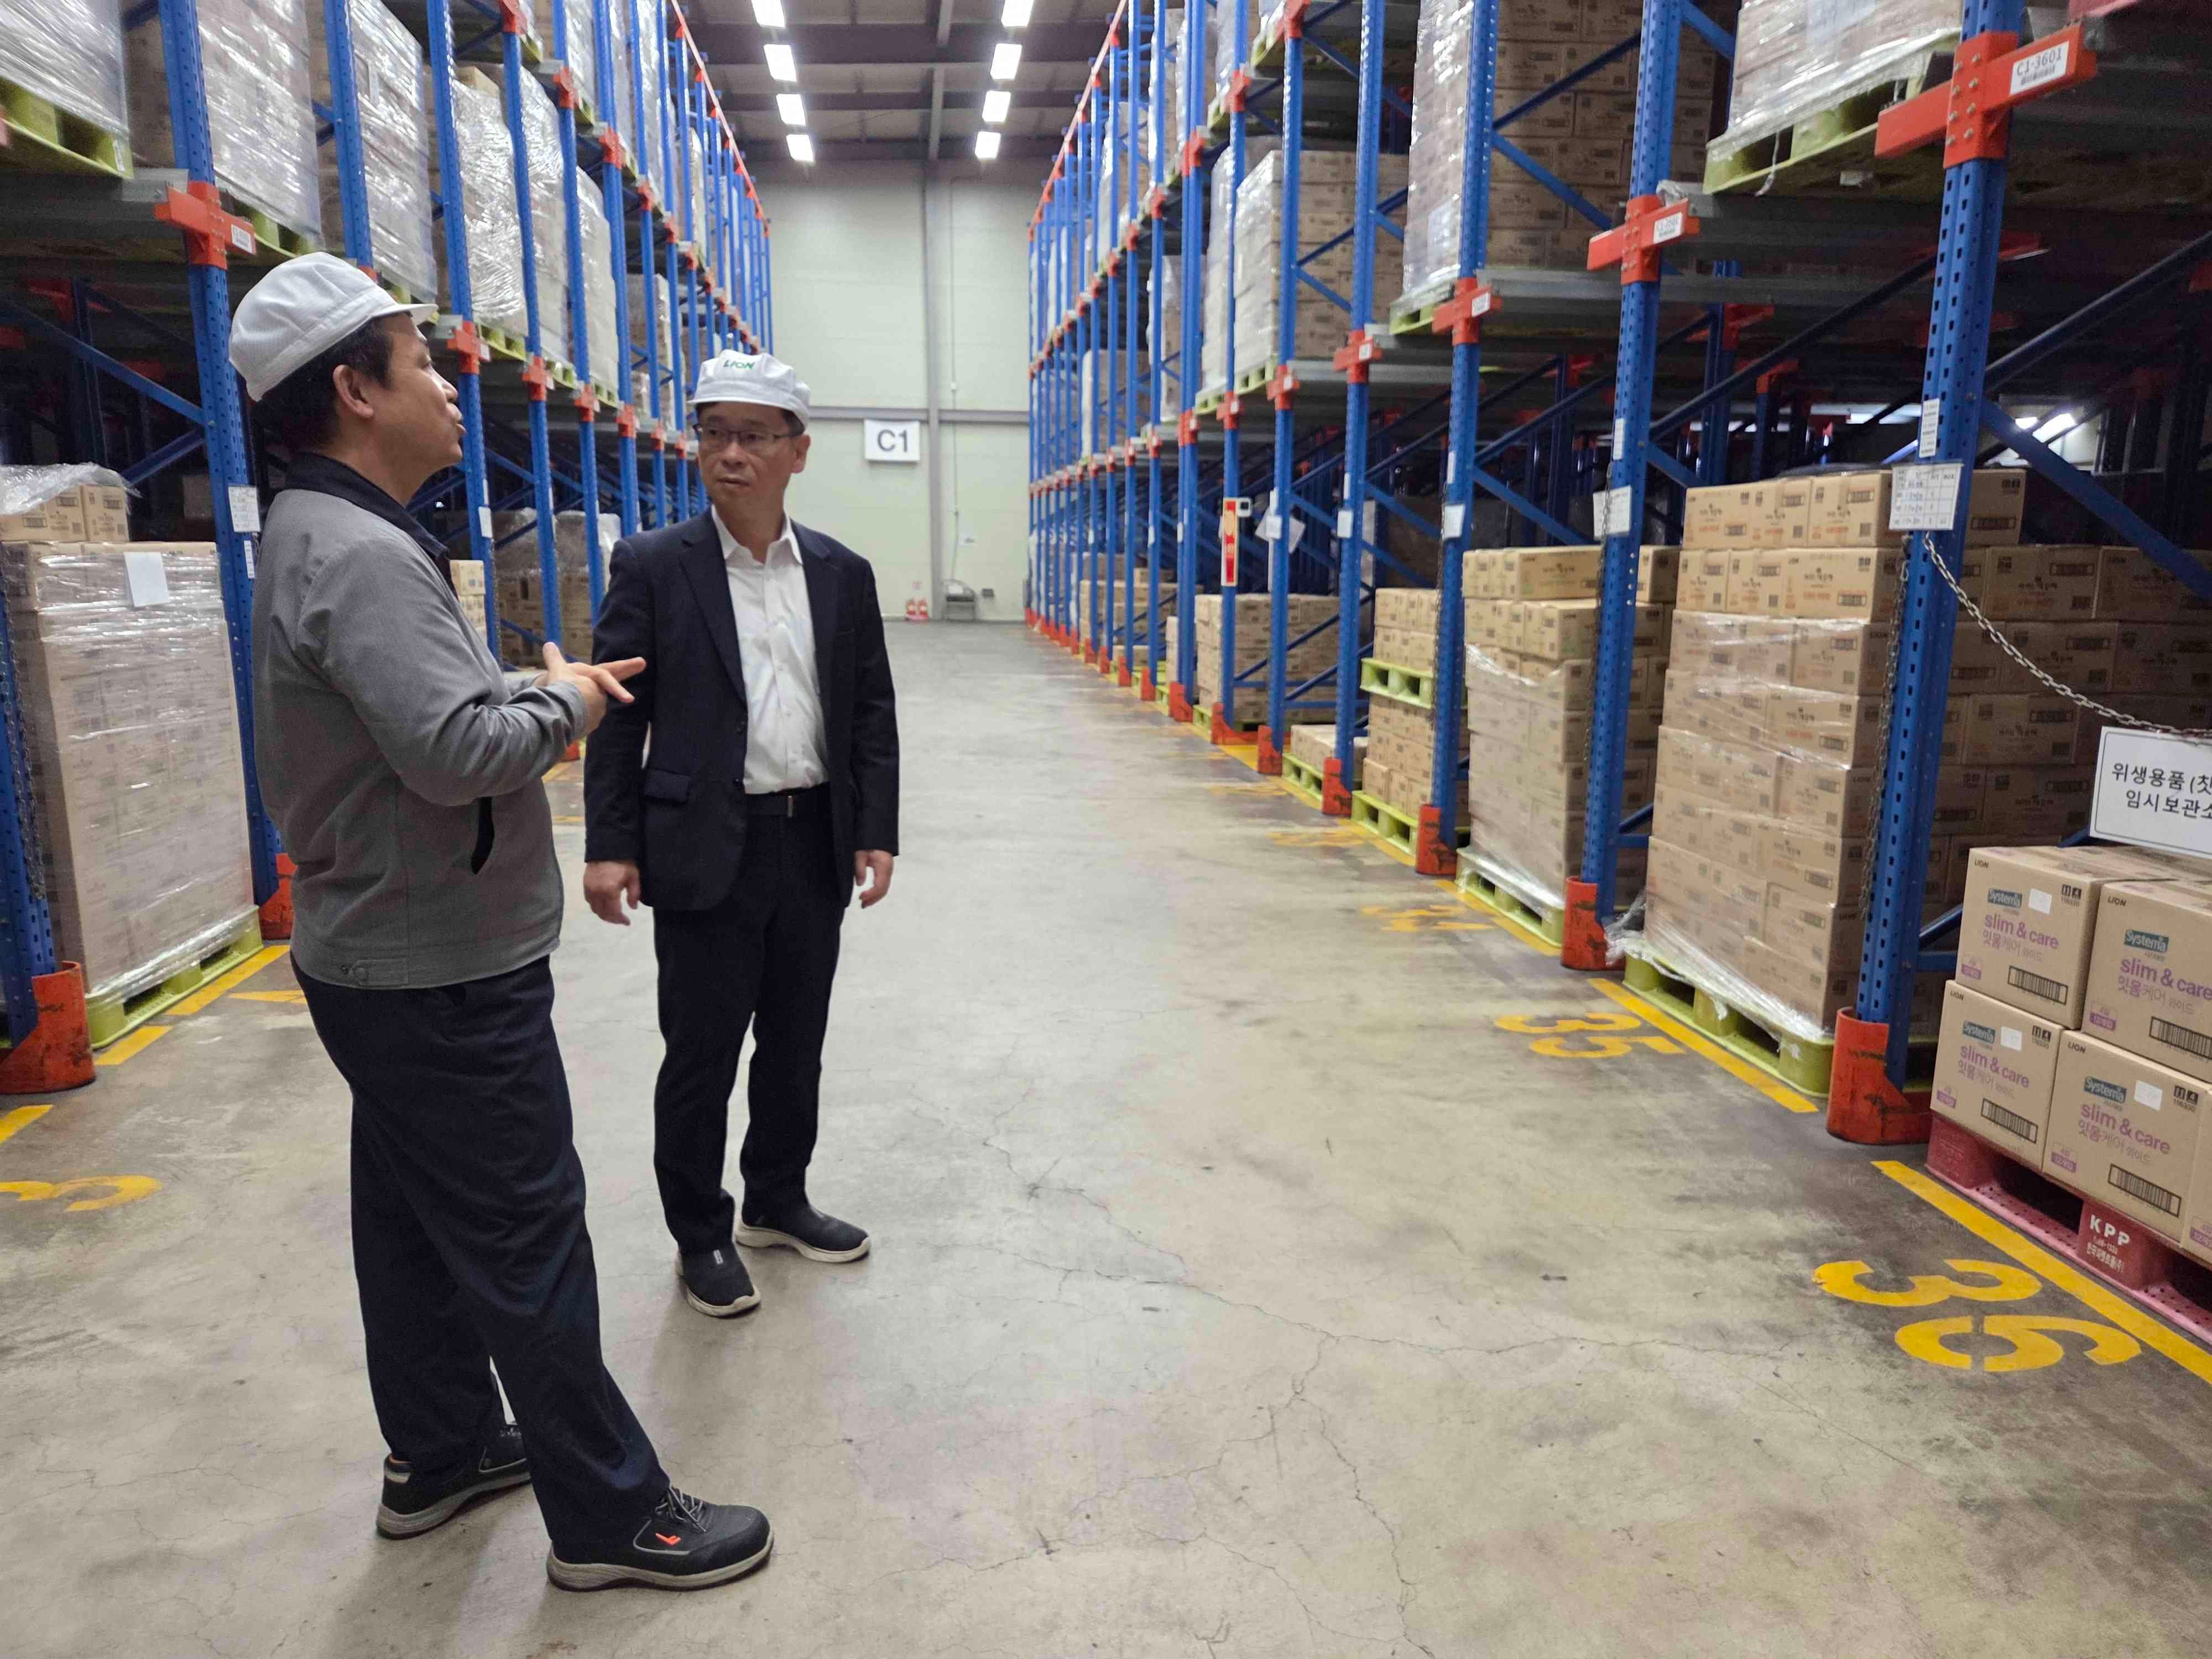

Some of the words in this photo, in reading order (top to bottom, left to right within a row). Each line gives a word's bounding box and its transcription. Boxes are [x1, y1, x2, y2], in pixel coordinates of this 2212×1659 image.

[723, 360, 755, 369] LION
[878, 429, 907, 452] C1
[2112, 763, 2185, 791] 위생용품
[1974, 859, 1989, 869] LION
[1988, 888, 2022, 907] Systema
[2107, 896, 2127, 906] LION
[1985, 914, 2014, 935] slim
[2017, 922, 2027, 938] &
[2030, 931, 2059, 949] care
[2125, 929, 2167, 952] Systema
[2118, 975, 2167, 1007] 잇몸케어
[2120, 958, 2157, 983] slim
[2161, 968, 2174, 988] &
[2177, 978, 2212, 1000] care
[1950, 990, 1964, 1000] LION
[1494, 1012, 1686, 1058] 35
[1964, 1021, 1995, 1043] Systema
[2068, 1041, 2087, 1053] LION
[1960, 1045, 1988, 1068] slim
[1990, 1057, 2000, 1074] &
[2002, 1066, 2030, 1088] care
[2085, 1076, 2125, 1103] Systema
[2080, 1104, 2116, 1130] slim
[2120, 1118, 2132, 1138] &
[2135, 1128, 2170, 1155] care
[2090, 1214, 2130, 1245] KPP
[1812, 1258, 2142, 1373] 36
